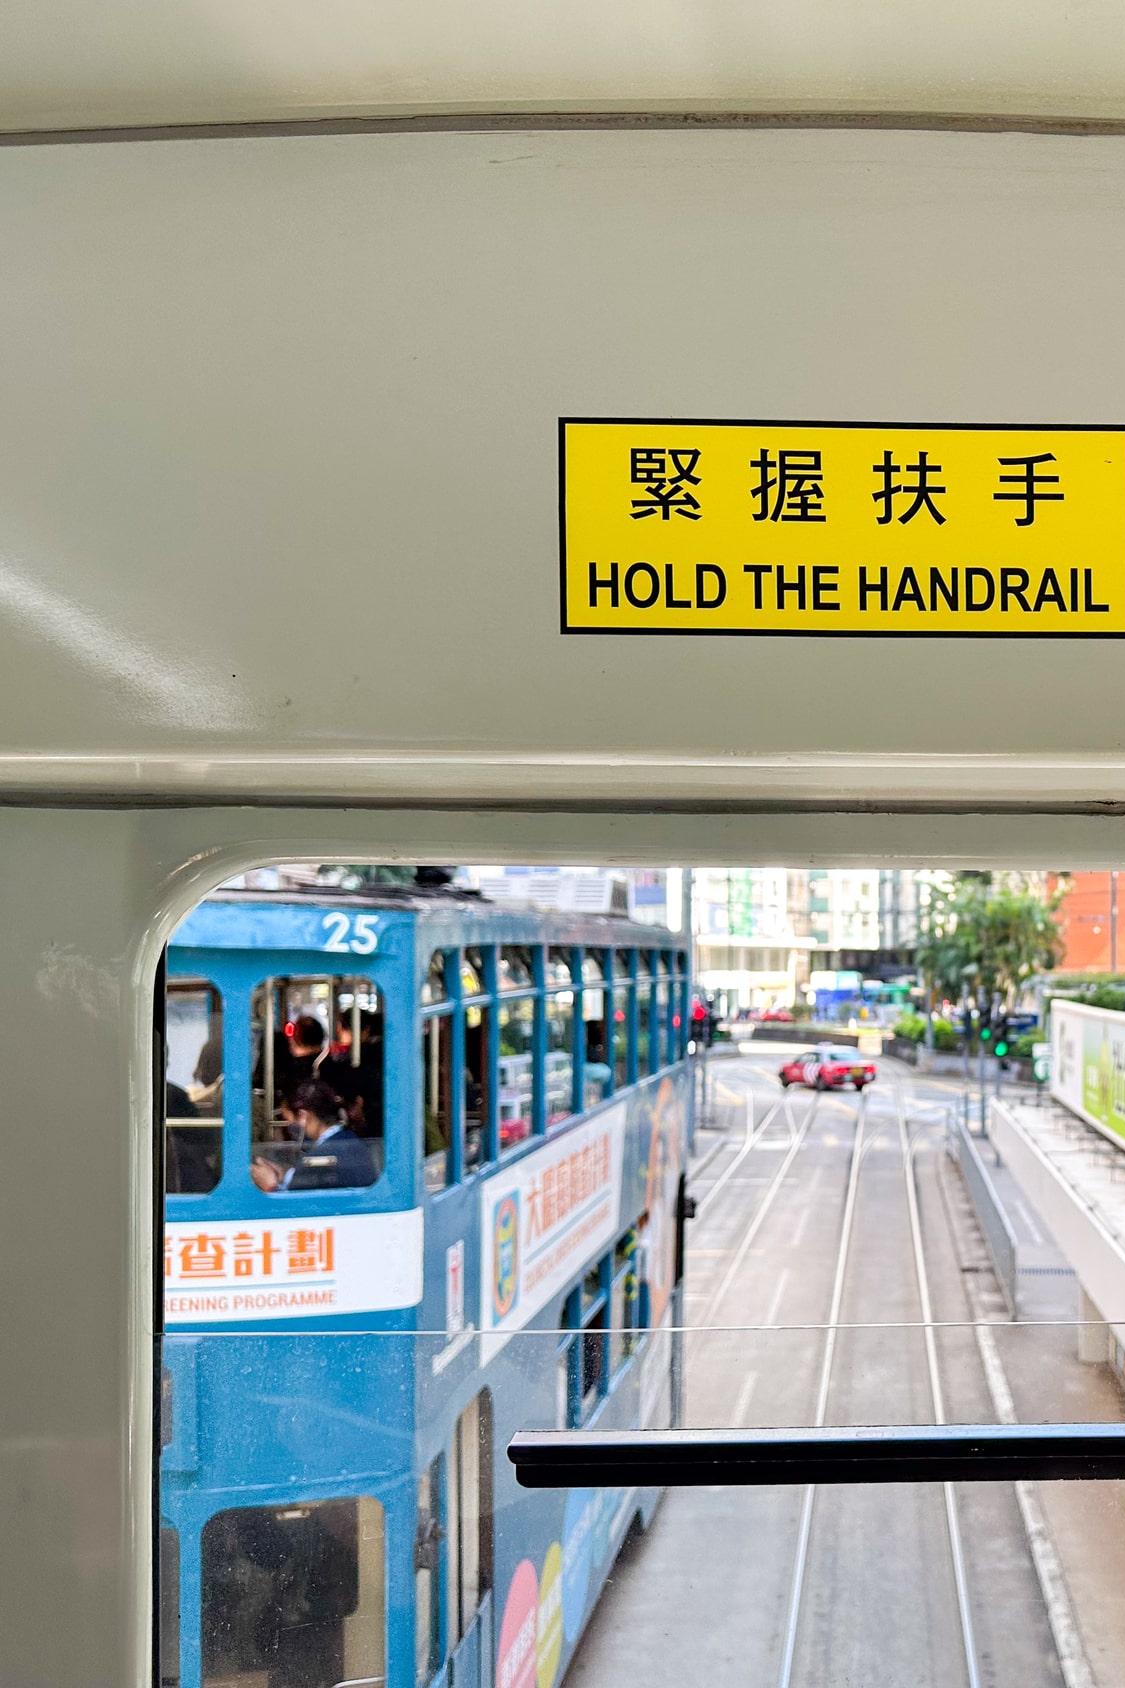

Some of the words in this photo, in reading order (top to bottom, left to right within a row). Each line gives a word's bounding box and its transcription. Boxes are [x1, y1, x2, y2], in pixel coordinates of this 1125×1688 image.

[628, 447, 1066, 527] 緊握扶手
[588, 561, 727, 609] HOLD
[743, 564, 841, 611] THE
[858, 566, 1110, 613] HANDRAIL
[322, 911, 380, 955] 25
[234, 1289, 337, 1309] PROGRAMME
